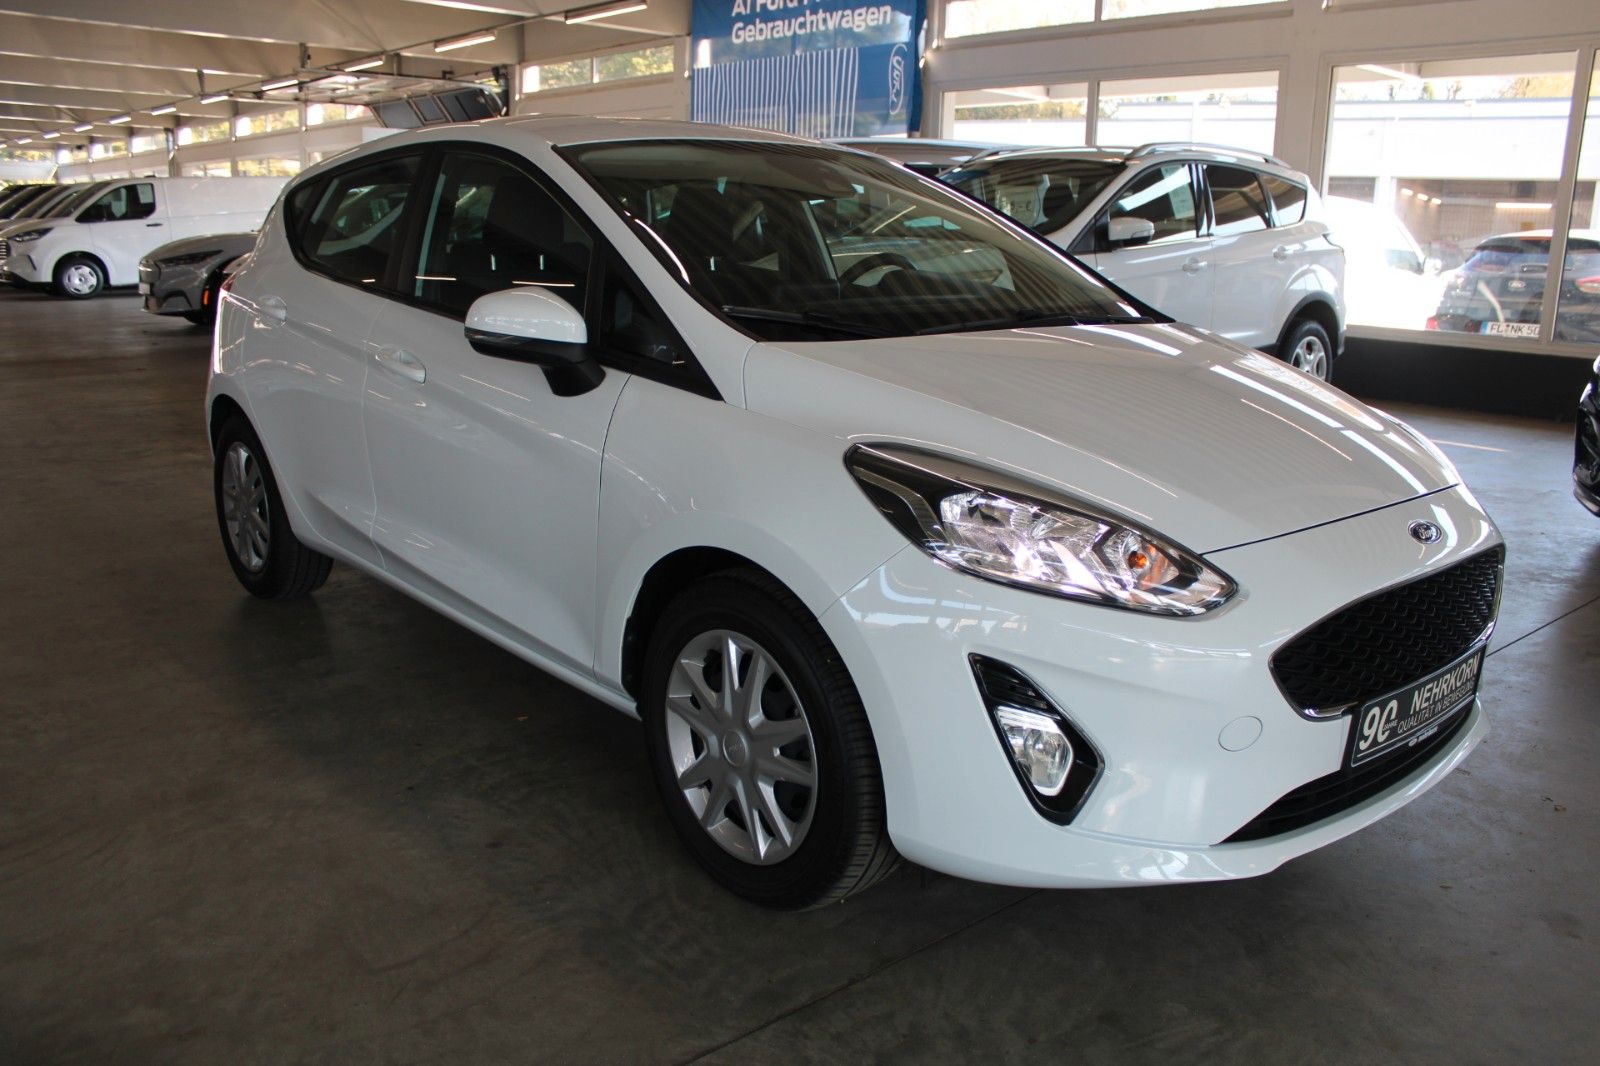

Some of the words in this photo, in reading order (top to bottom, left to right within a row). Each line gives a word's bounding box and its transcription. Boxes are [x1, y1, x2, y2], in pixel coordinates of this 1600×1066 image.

[731, 5, 893, 44] Gebrauchtwagen
[1490, 323, 1503, 334] FL
[1511, 324, 1524, 335] NK
[1410, 652, 1481, 715] NEHRKORN
[1397, 703, 1435, 734] QUALITÄT
